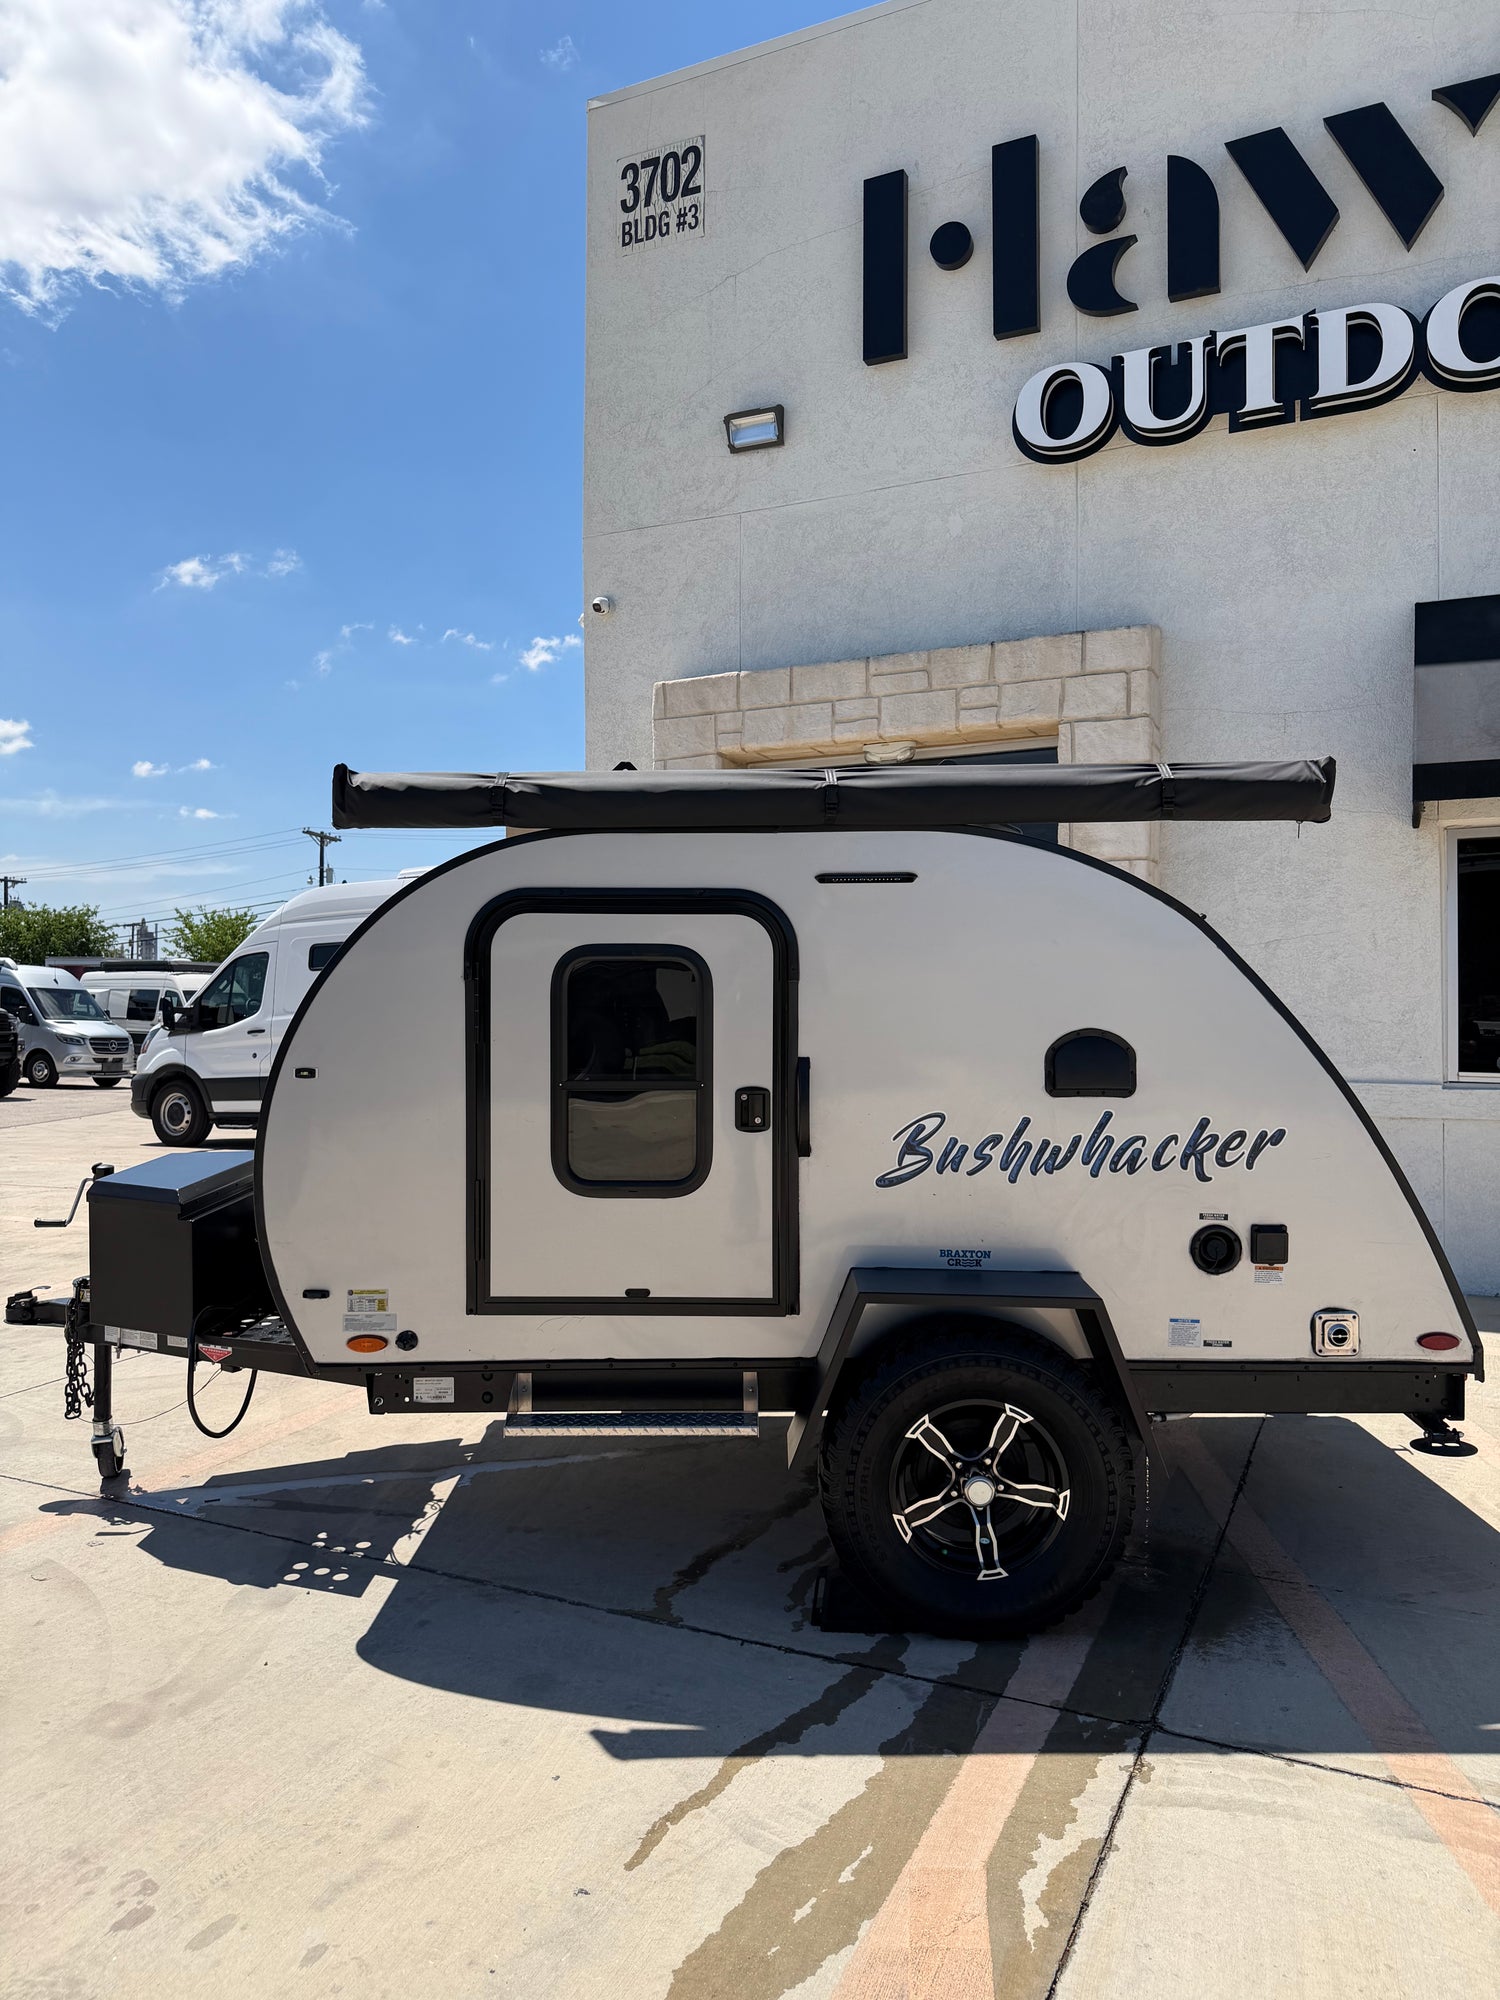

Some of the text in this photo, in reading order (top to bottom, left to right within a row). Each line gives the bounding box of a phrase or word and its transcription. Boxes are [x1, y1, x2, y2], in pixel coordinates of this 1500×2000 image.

[621, 146, 701, 213] 3702
[621, 203, 699, 247] BLDG #3
[875, 1110, 1287, 1188] Bushwhacker
[939, 1249, 992, 1259] BRAXTON
